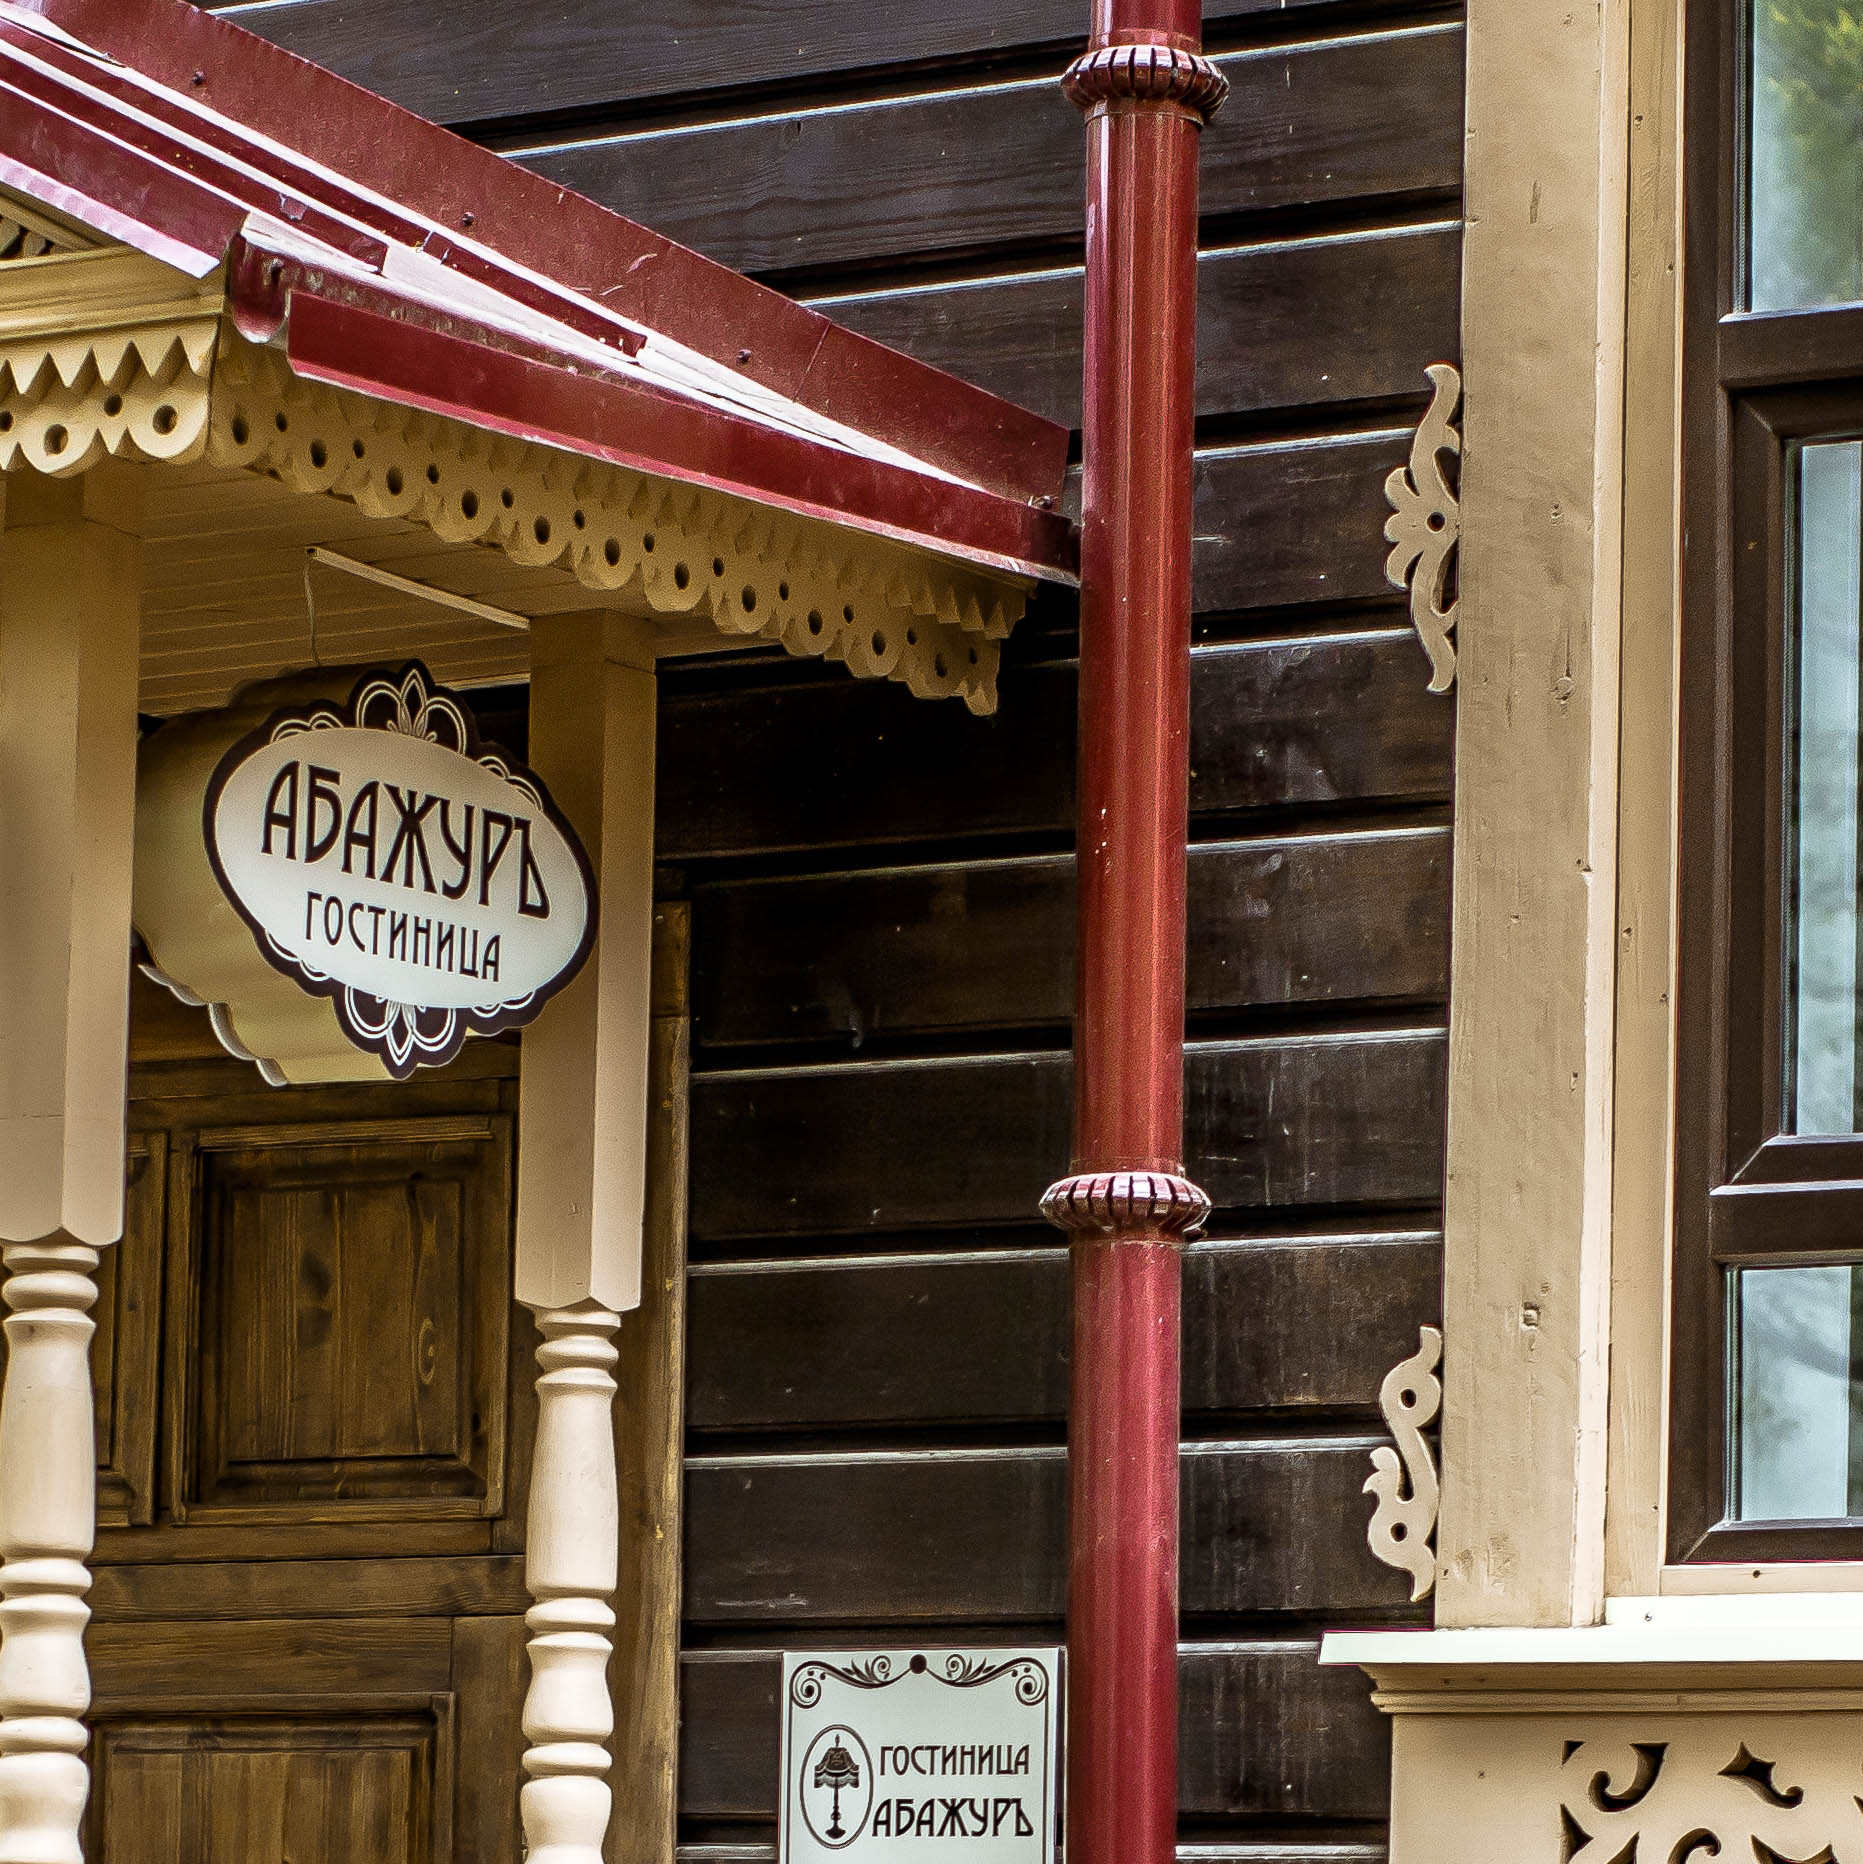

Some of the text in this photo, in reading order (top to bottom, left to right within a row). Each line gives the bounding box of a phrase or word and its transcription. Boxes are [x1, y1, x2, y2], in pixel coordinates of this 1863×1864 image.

[261, 760, 550, 920] АБАЖУРЪ
[305, 891, 501, 983] ГОСТИНИЦА
[880, 1745, 1030, 1776] ГОСТИНИЦА
[872, 1798, 1034, 1837] АБАЖУРЪ
